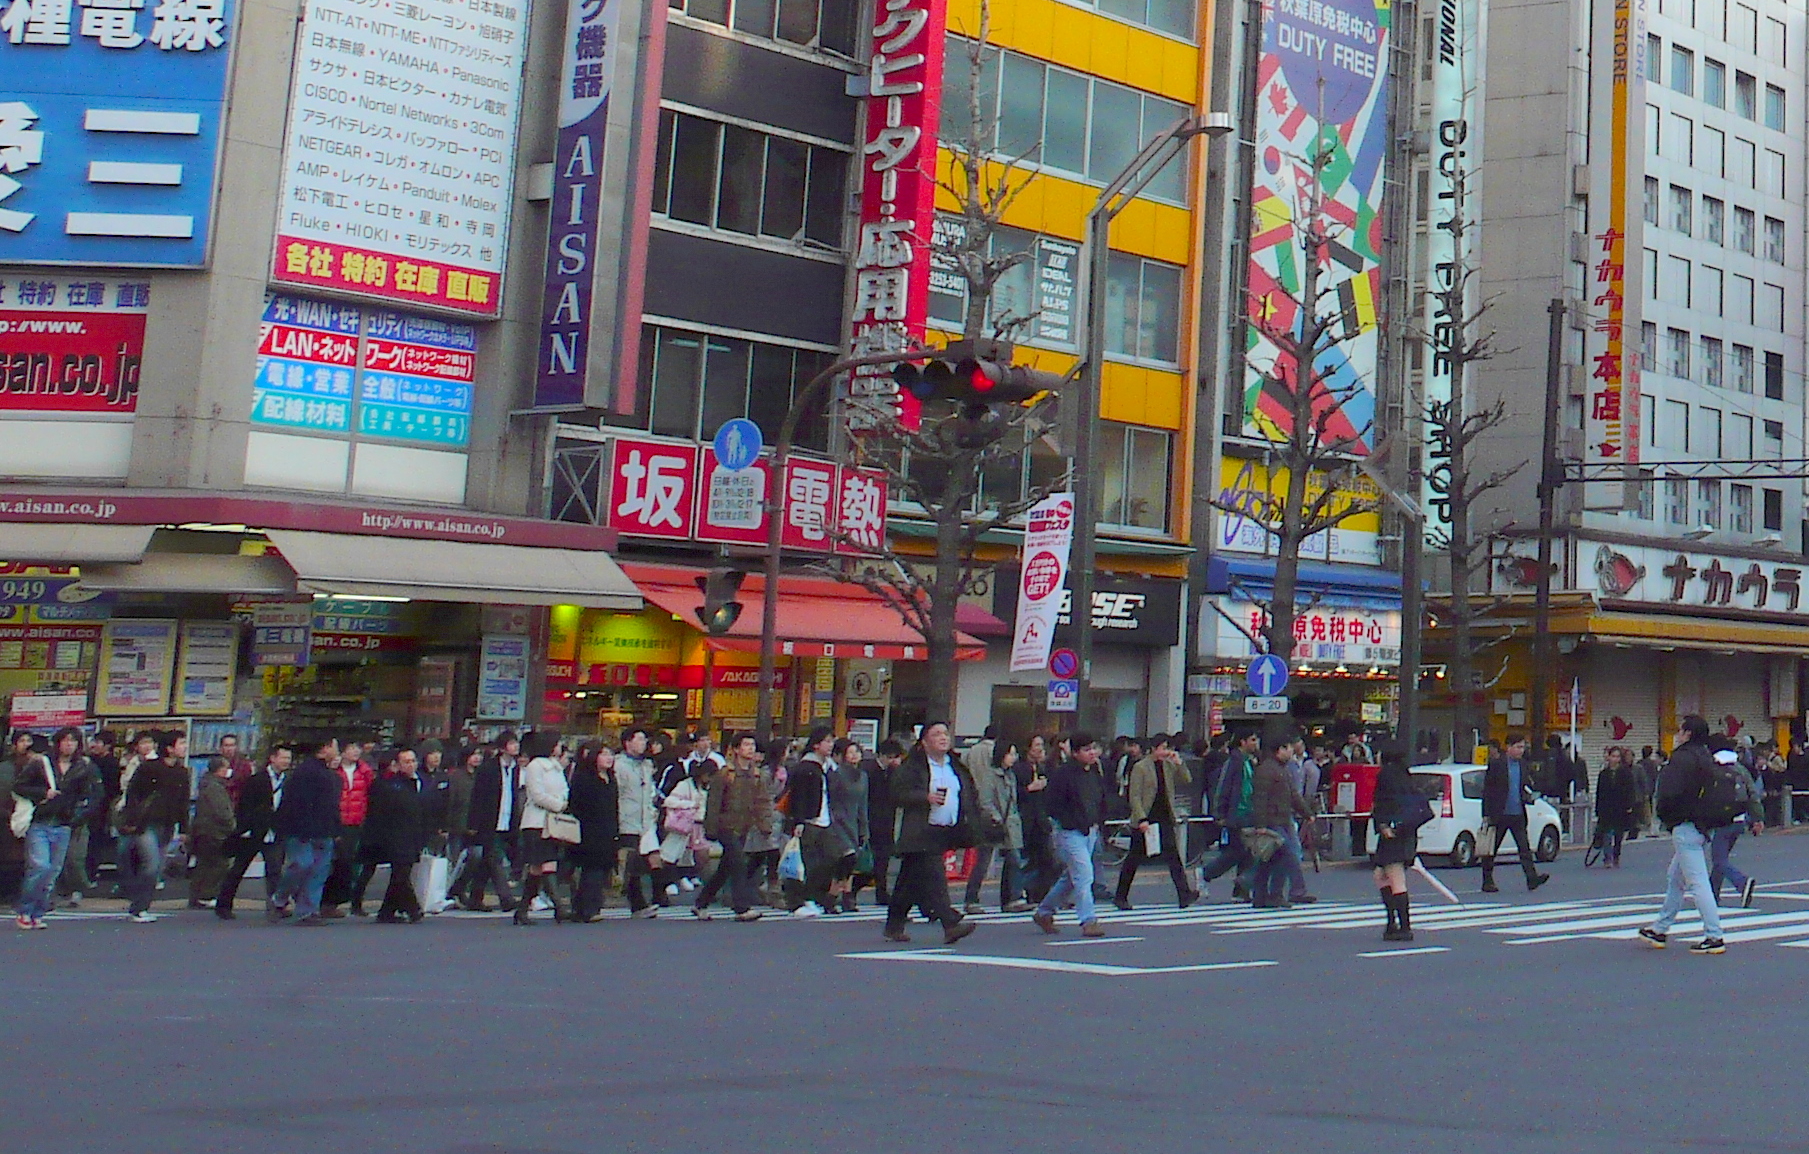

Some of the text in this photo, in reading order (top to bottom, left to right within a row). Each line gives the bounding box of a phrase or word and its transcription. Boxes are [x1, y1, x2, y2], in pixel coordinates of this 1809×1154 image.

[1278, 25, 1375, 79] DUTY FREE
[1614, 17, 1626, 86] STORE
[286, 242, 491, 304] 各社 特約 在庫 直販
[547, 136, 593, 376] AISAN
[18, 280, 57, 306] 特約
[68, 282, 105, 308] 在庫
[1592, 228, 1624, 420] ナカウラ本店
[362, 512, 504, 538] http://www.aisan.co.jp
[1663, 554, 1802, 611] ナカウラ
